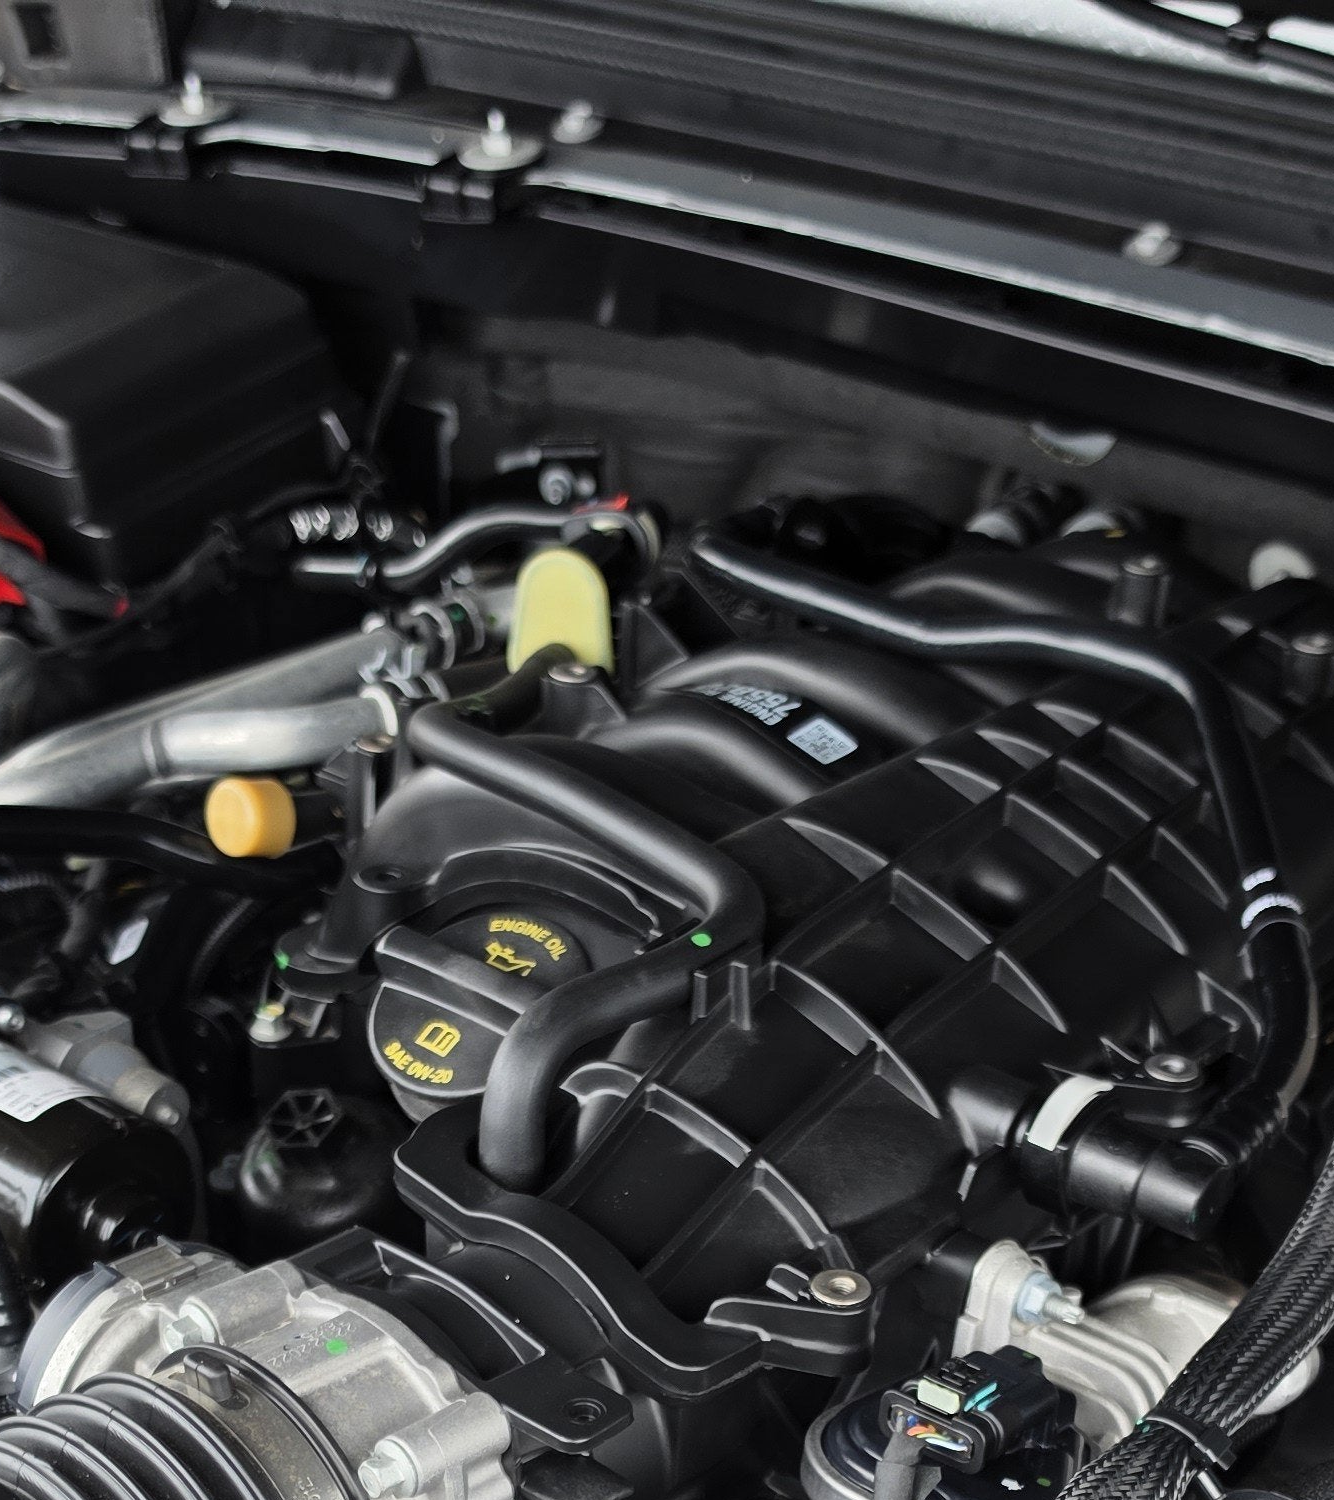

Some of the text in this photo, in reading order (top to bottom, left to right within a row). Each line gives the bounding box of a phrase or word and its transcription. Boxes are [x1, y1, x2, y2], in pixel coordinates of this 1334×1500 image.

[489, 918, 567, 961] ENGINE OIL
[384, 1042, 454, 1084] SAE 0W-20
